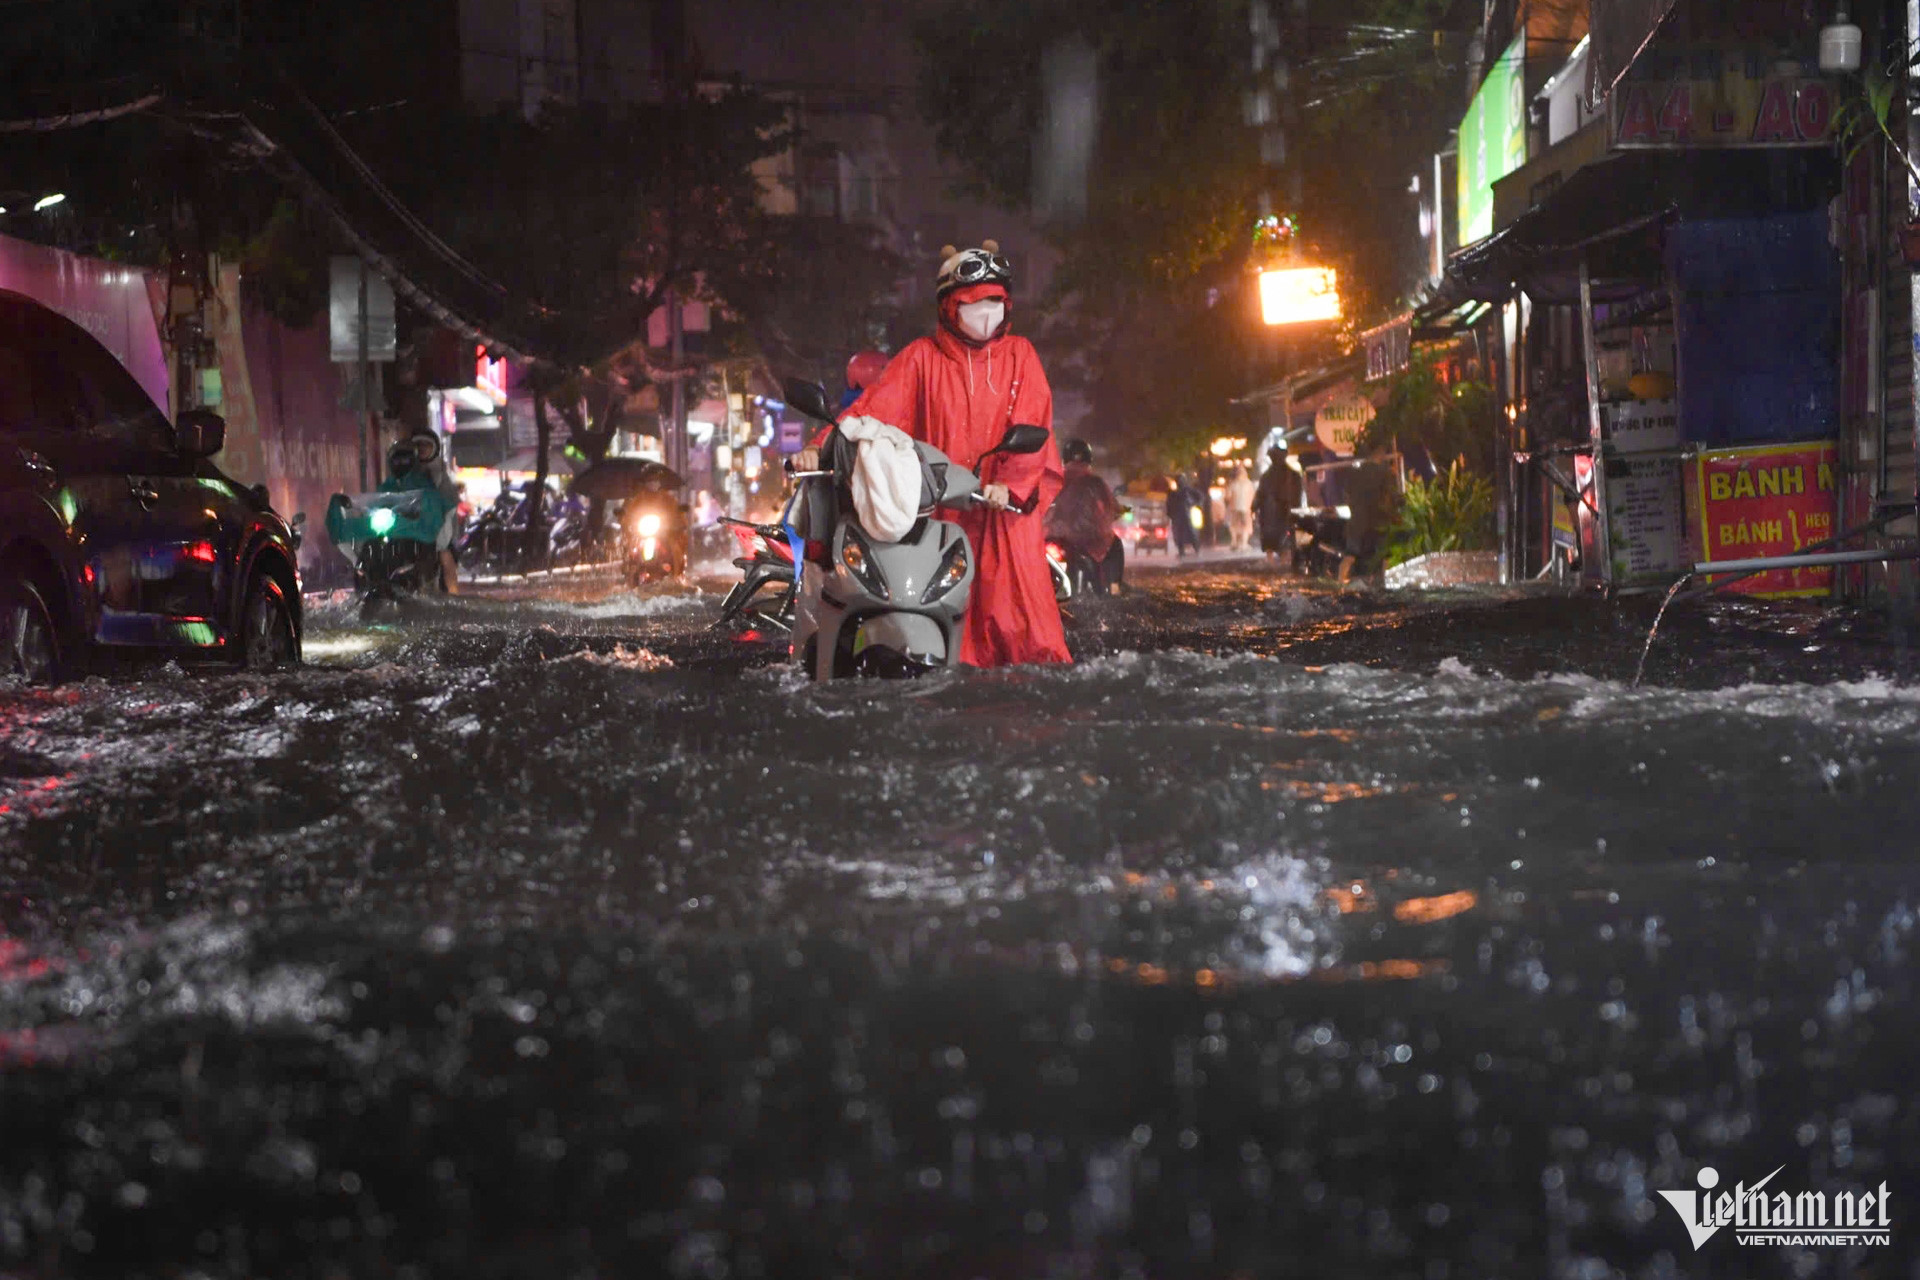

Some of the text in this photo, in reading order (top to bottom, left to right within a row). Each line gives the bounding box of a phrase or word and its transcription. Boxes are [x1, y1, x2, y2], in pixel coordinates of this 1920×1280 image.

[1619, 86, 1694, 143] A4
[1709, 460, 1805, 501] BÁNH
[1719, 516, 1783, 547] BÁNH
